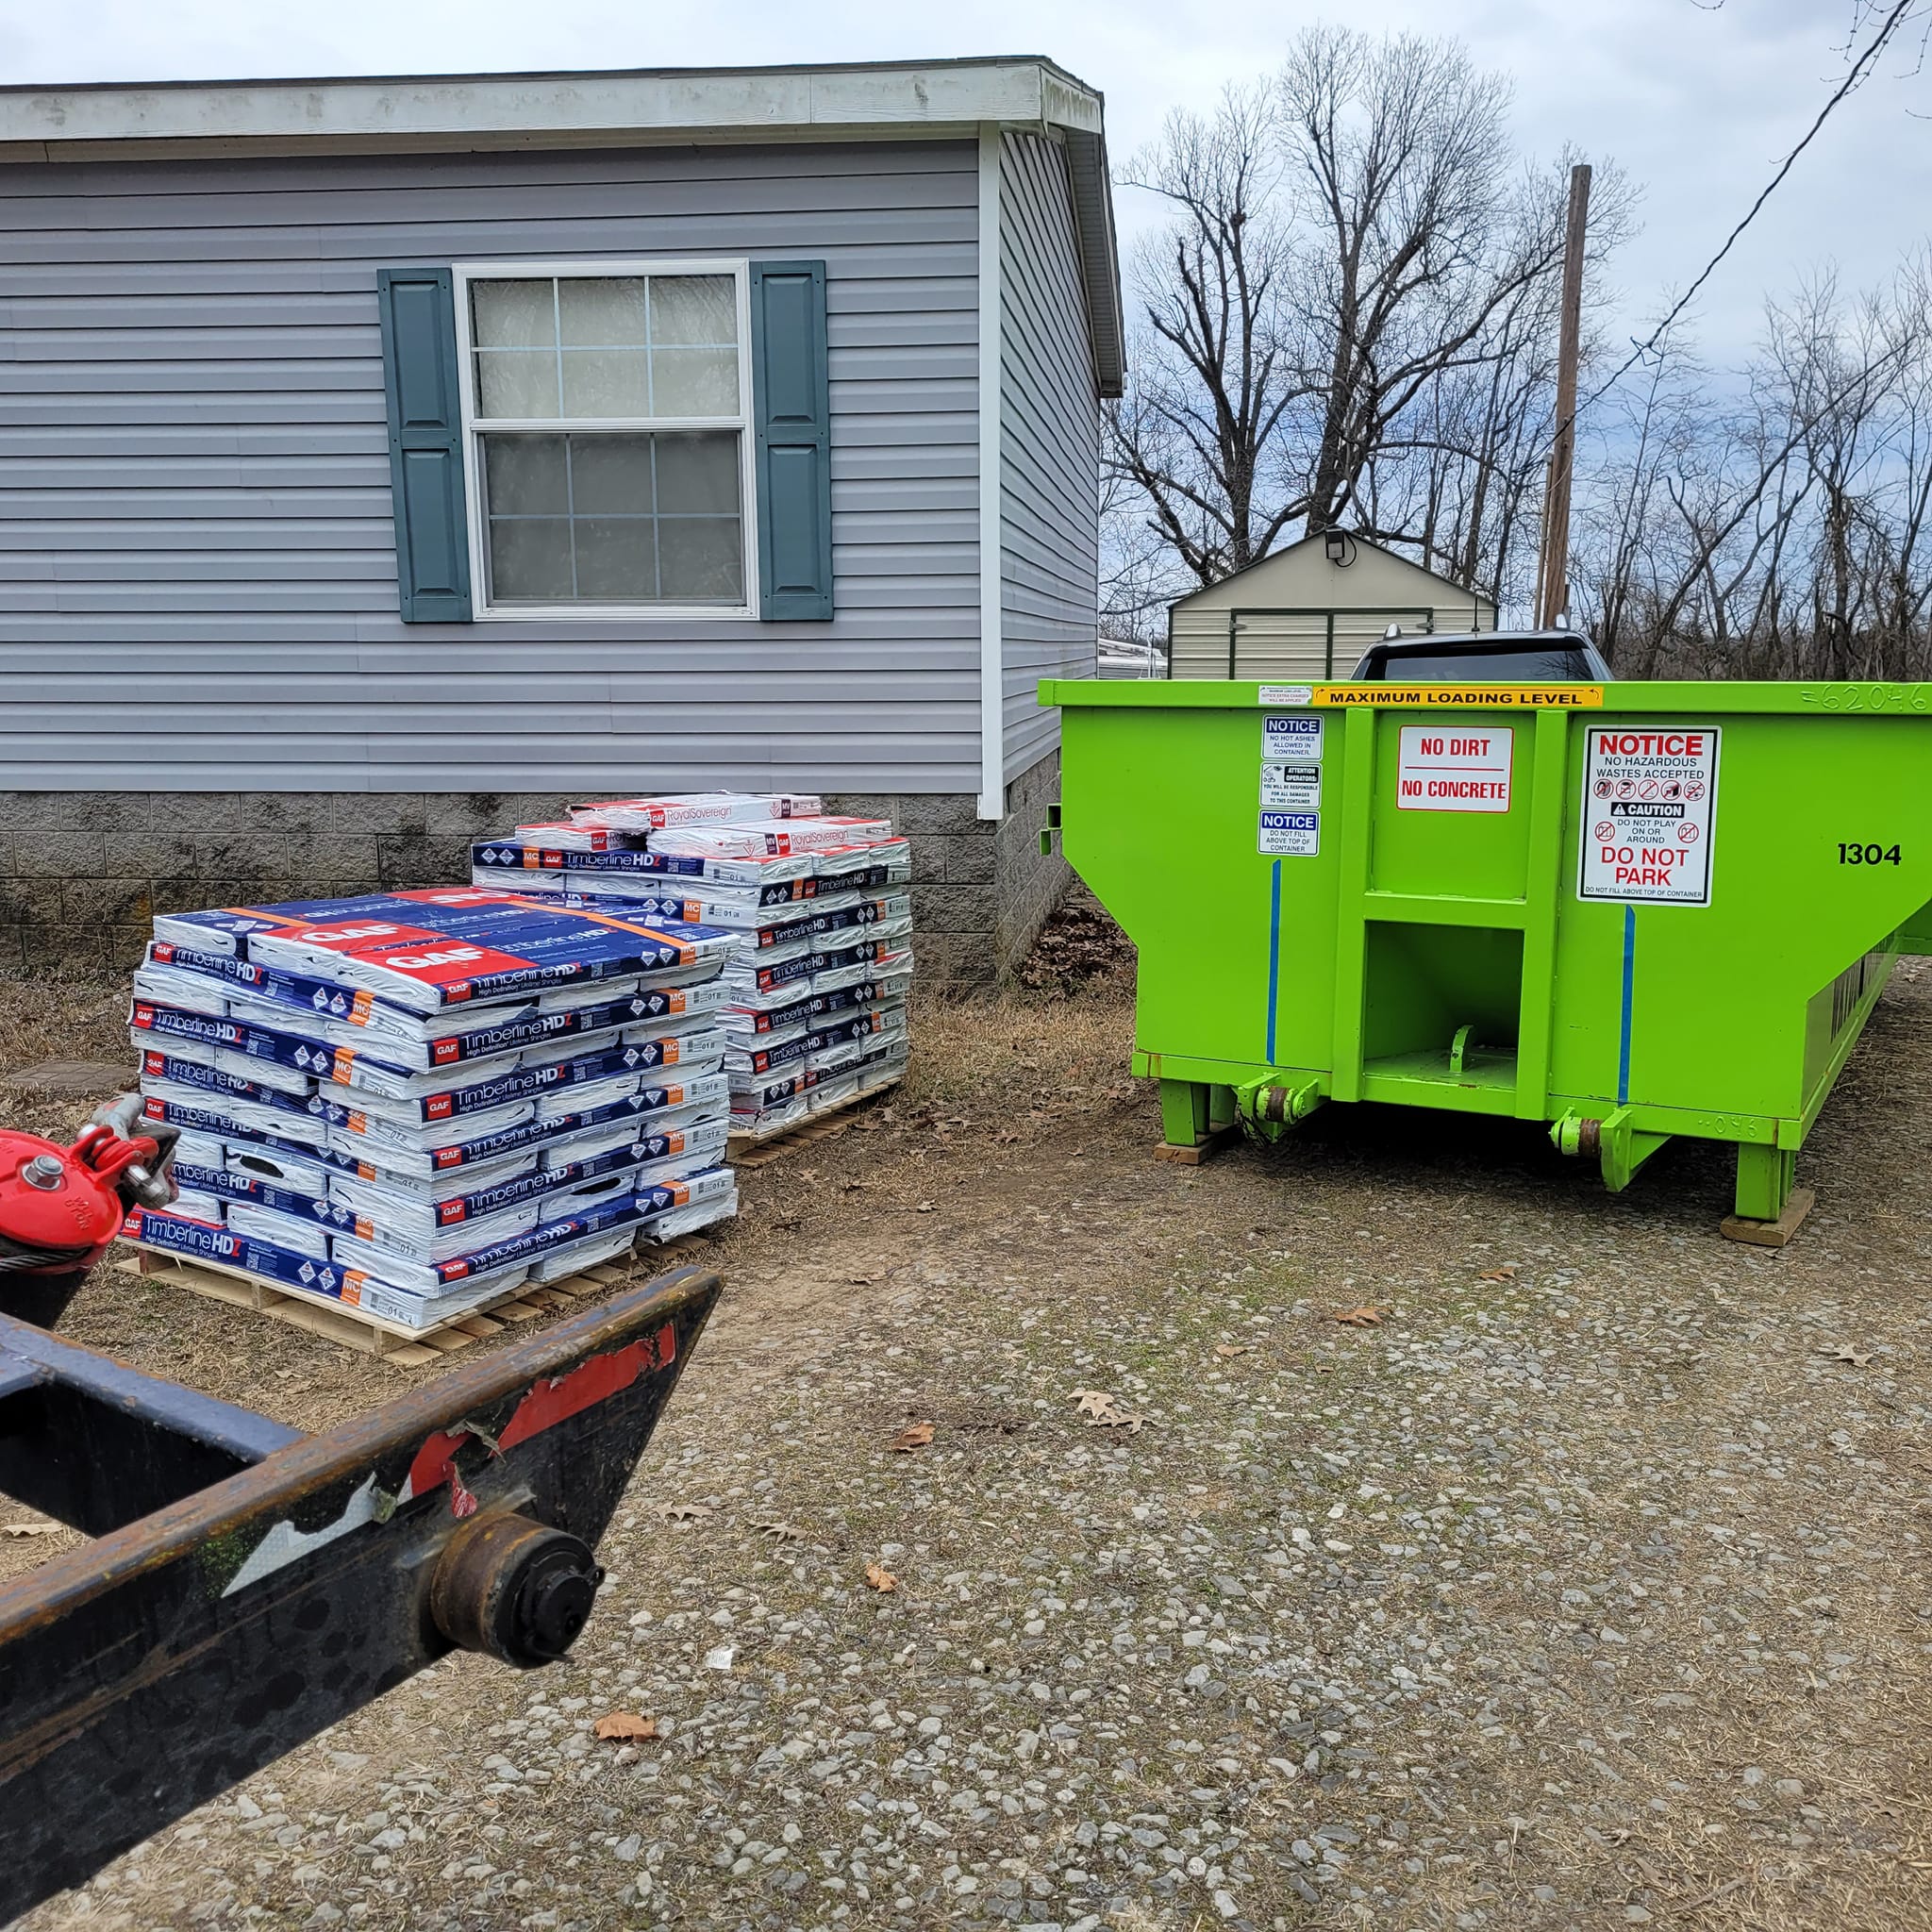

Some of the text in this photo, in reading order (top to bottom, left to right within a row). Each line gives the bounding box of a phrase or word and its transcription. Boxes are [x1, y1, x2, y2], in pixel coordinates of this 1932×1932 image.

[1329, 692, 1582, 705] MAXIMUM LOADING LEVEL
[1269, 720, 1317, 732] NOTICE
[1421, 739, 1491, 757] NO DIRT
[1599, 735, 1704, 756] NOTICE
[1605, 757, 1697, 767] NO HAZARDOUS
[1596, 769, 1705, 779] WASTES ACCEPTED
[1402, 780, 1507, 799] NO CONCRETE
[1627, 804, 1682, 816] CAUTION
[652, 814, 665, 823] GAF
[1263, 815, 1314, 828] NOTICE
[592, 836, 607, 844] GAF
[778, 838, 789, 846] GAF
[1626, 836, 1665, 844] AROUND
[524, 852, 539, 861] MC
[1601, 846, 1690, 867] DO NOT
[1838, 842, 1902, 866] 1304
[1616, 867, 1672, 887] PARK
[685, 904, 700, 912] MC
[301, 924, 400, 942] GAF
[156, 945, 171, 956] GAF
[385, 946, 485, 969] GAF
[759, 975, 771, 984] GAF
[448, 984, 468, 993] GAF
[478, 988, 491, 996] High
[670, 992, 685, 1002] MC
[353, 1003, 369, 1016] MC
[137, 1010, 152, 1020] GAF
[758, 1021, 769, 1029] GAF
[437, 1044, 458, 1055] GAF
[466, 1049, 481, 1058] High
[663, 1043, 678, 1054] MC
[334, 1060, 352, 1074] MC
[147, 1104, 163, 1113] GAF
[429, 1101, 450, 1112] GAF
[459, 1104, 474, 1113] High
[670, 1132, 684, 1142] MC
[440, 1151, 459, 1161] GAF
[469, 1153, 483, 1161] High
[443, 1205, 463, 1216] GAF
[472, 1207, 486, 1216] High
[125, 1218, 141, 1229] GAF
[444, 1263, 467, 1273] GAF
[475, 1263, 488, 1273] High
[344, 1279, 360, 1293] MC
